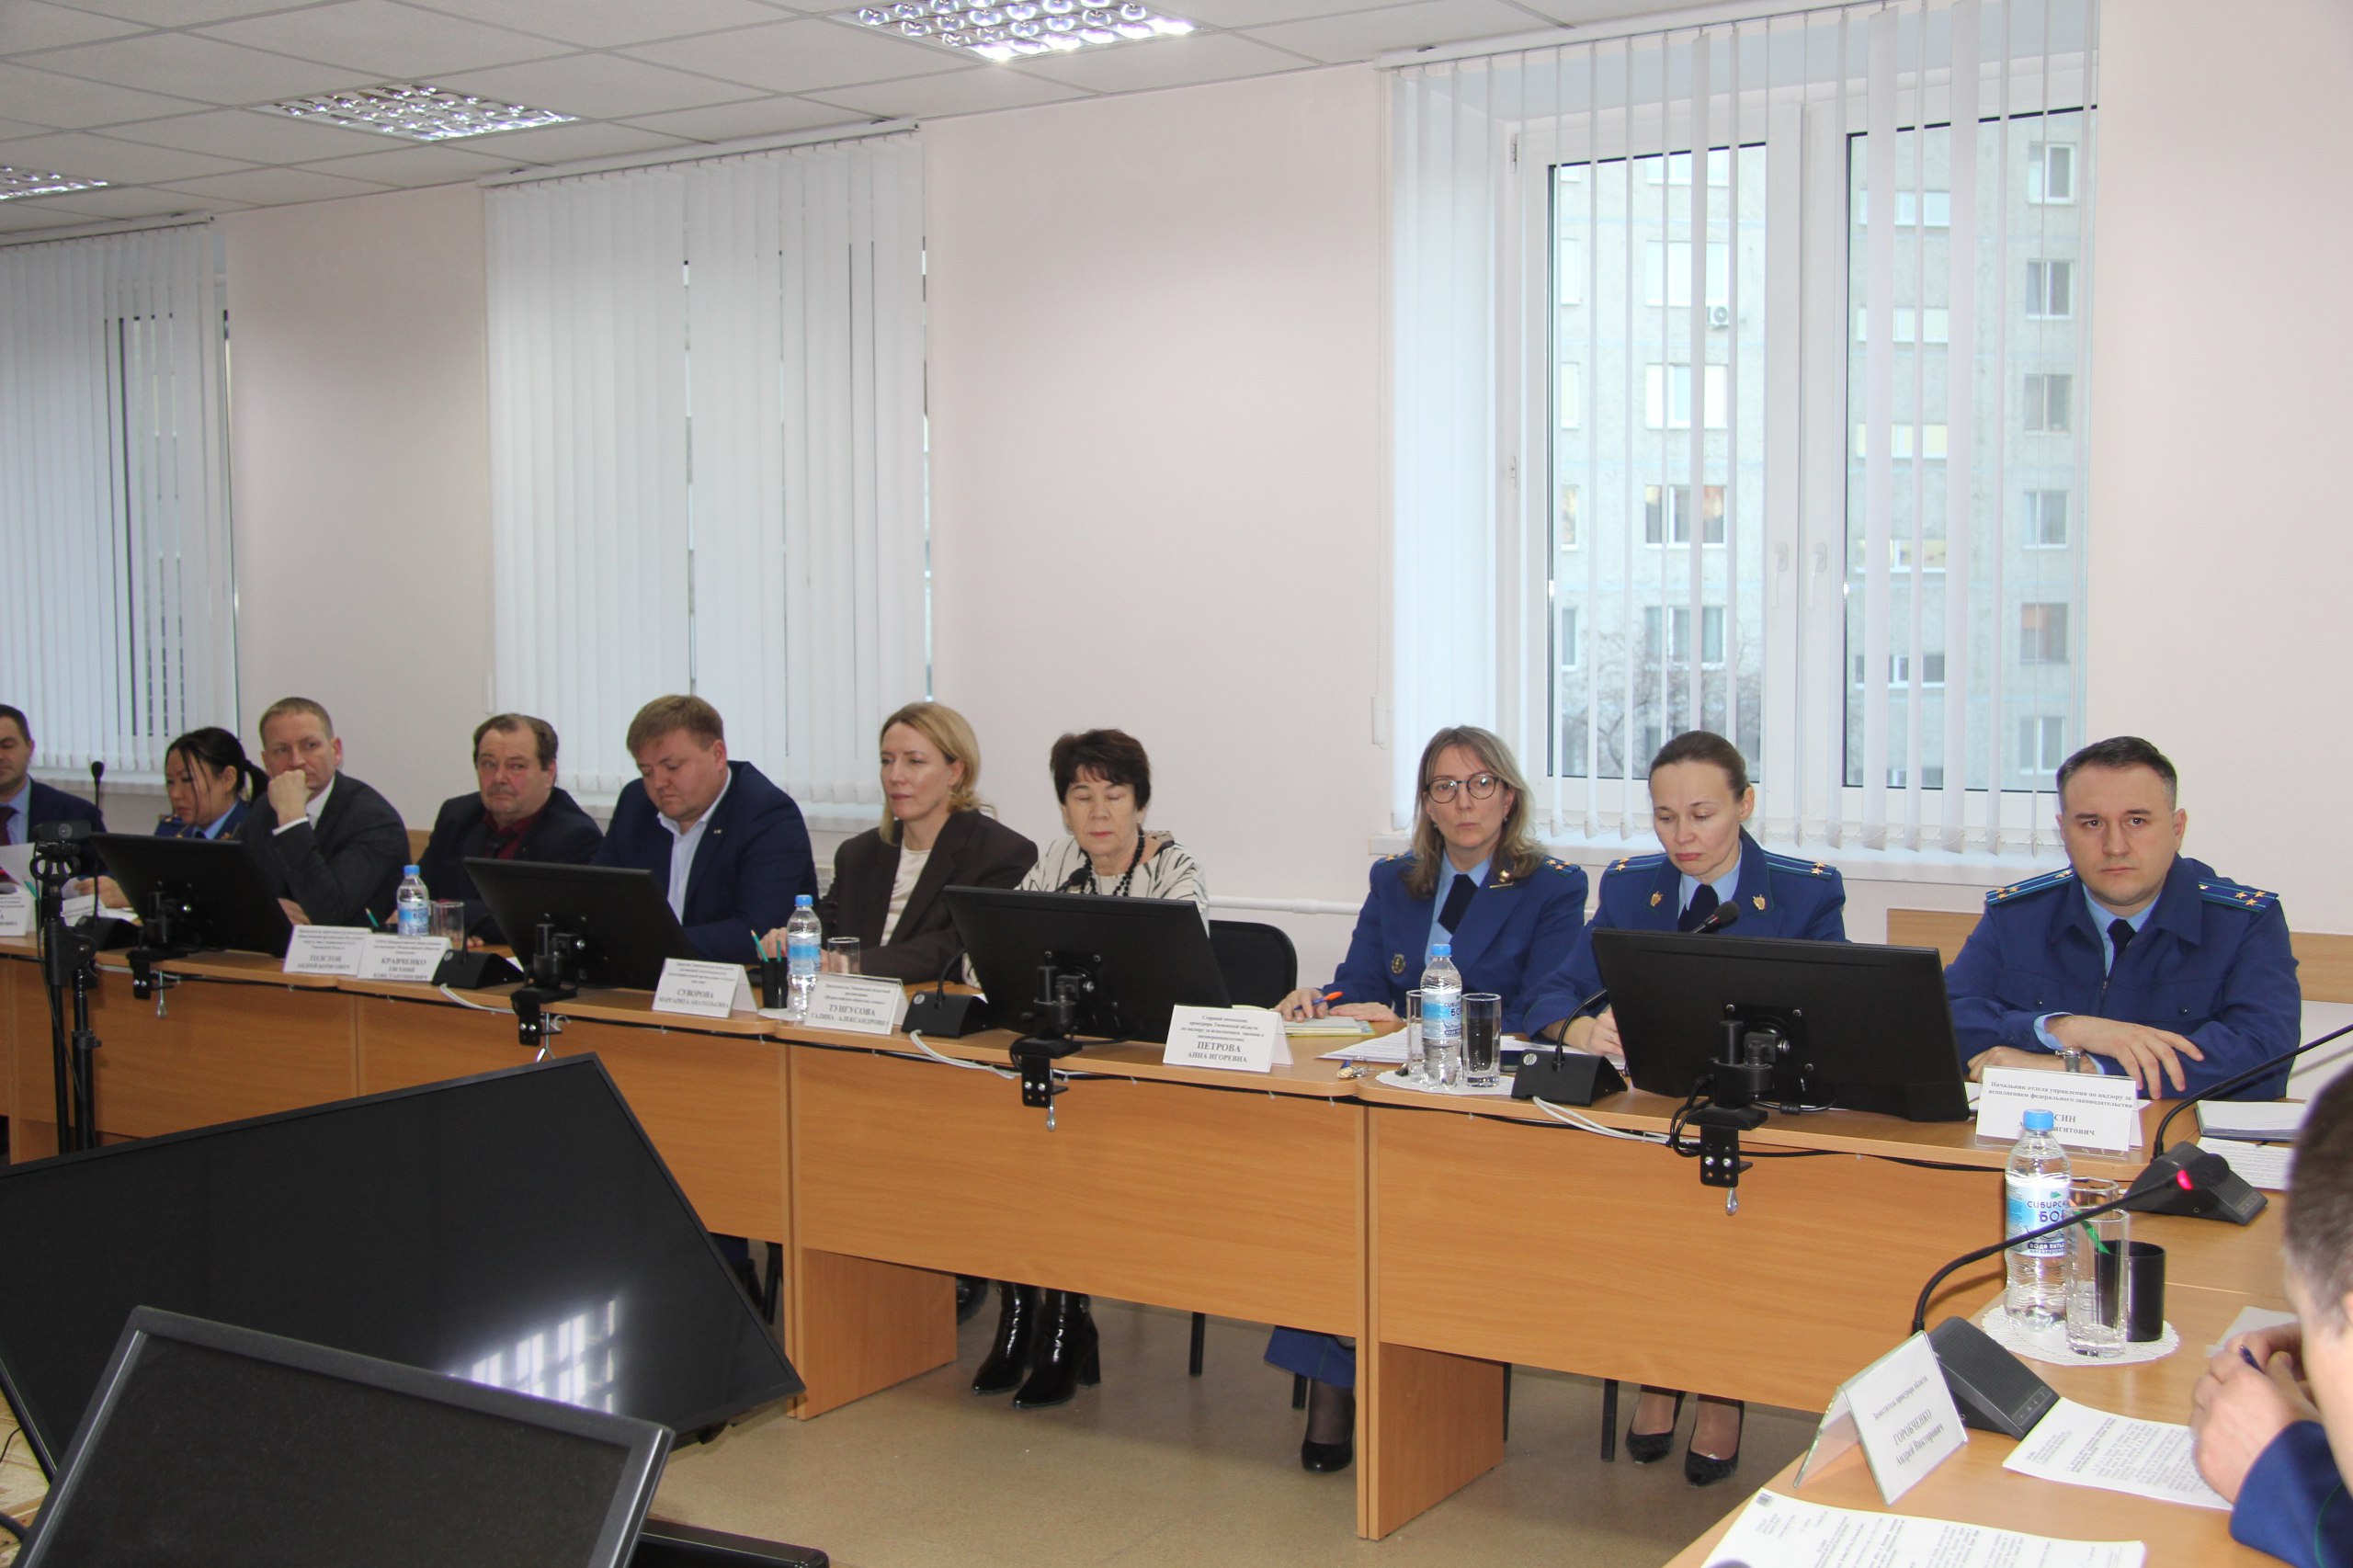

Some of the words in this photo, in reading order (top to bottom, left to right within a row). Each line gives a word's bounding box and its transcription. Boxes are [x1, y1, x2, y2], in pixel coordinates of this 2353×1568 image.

[381, 958, 427, 966] КРАВЧЕНКО
[676, 988, 714, 999] СУВОРОВА
[659, 996, 690, 1006] МАРГАРИТА
[829, 1004, 876, 1017] ТУНГУСОВА
[811, 1012, 835, 1021] ГАЛИНА
[838, 1015, 890, 1027] АЛЕКСАНДРОВНА
[1197, 1041, 1241, 1053] ПЕТРОВА
[1188, 1051, 1208, 1060] АННА
[1209, 1053, 1247, 1063] ИГОРЕВНА
[1991, 1081, 2026, 1091] Начальник
[2050, 1087, 2087, 1097] управления
[1988, 1090, 2029, 1098] исполнением
[2029, 1092, 2075, 1103] федерального
[2075, 1098, 2132, 1108] законодательства
[1893, 1408, 1932, 1446] ГОРОБЧЕНКО
[1896, 1445, 1915, 1465] Андрей
[1912, 1423, 1945, 1451] Викторович
